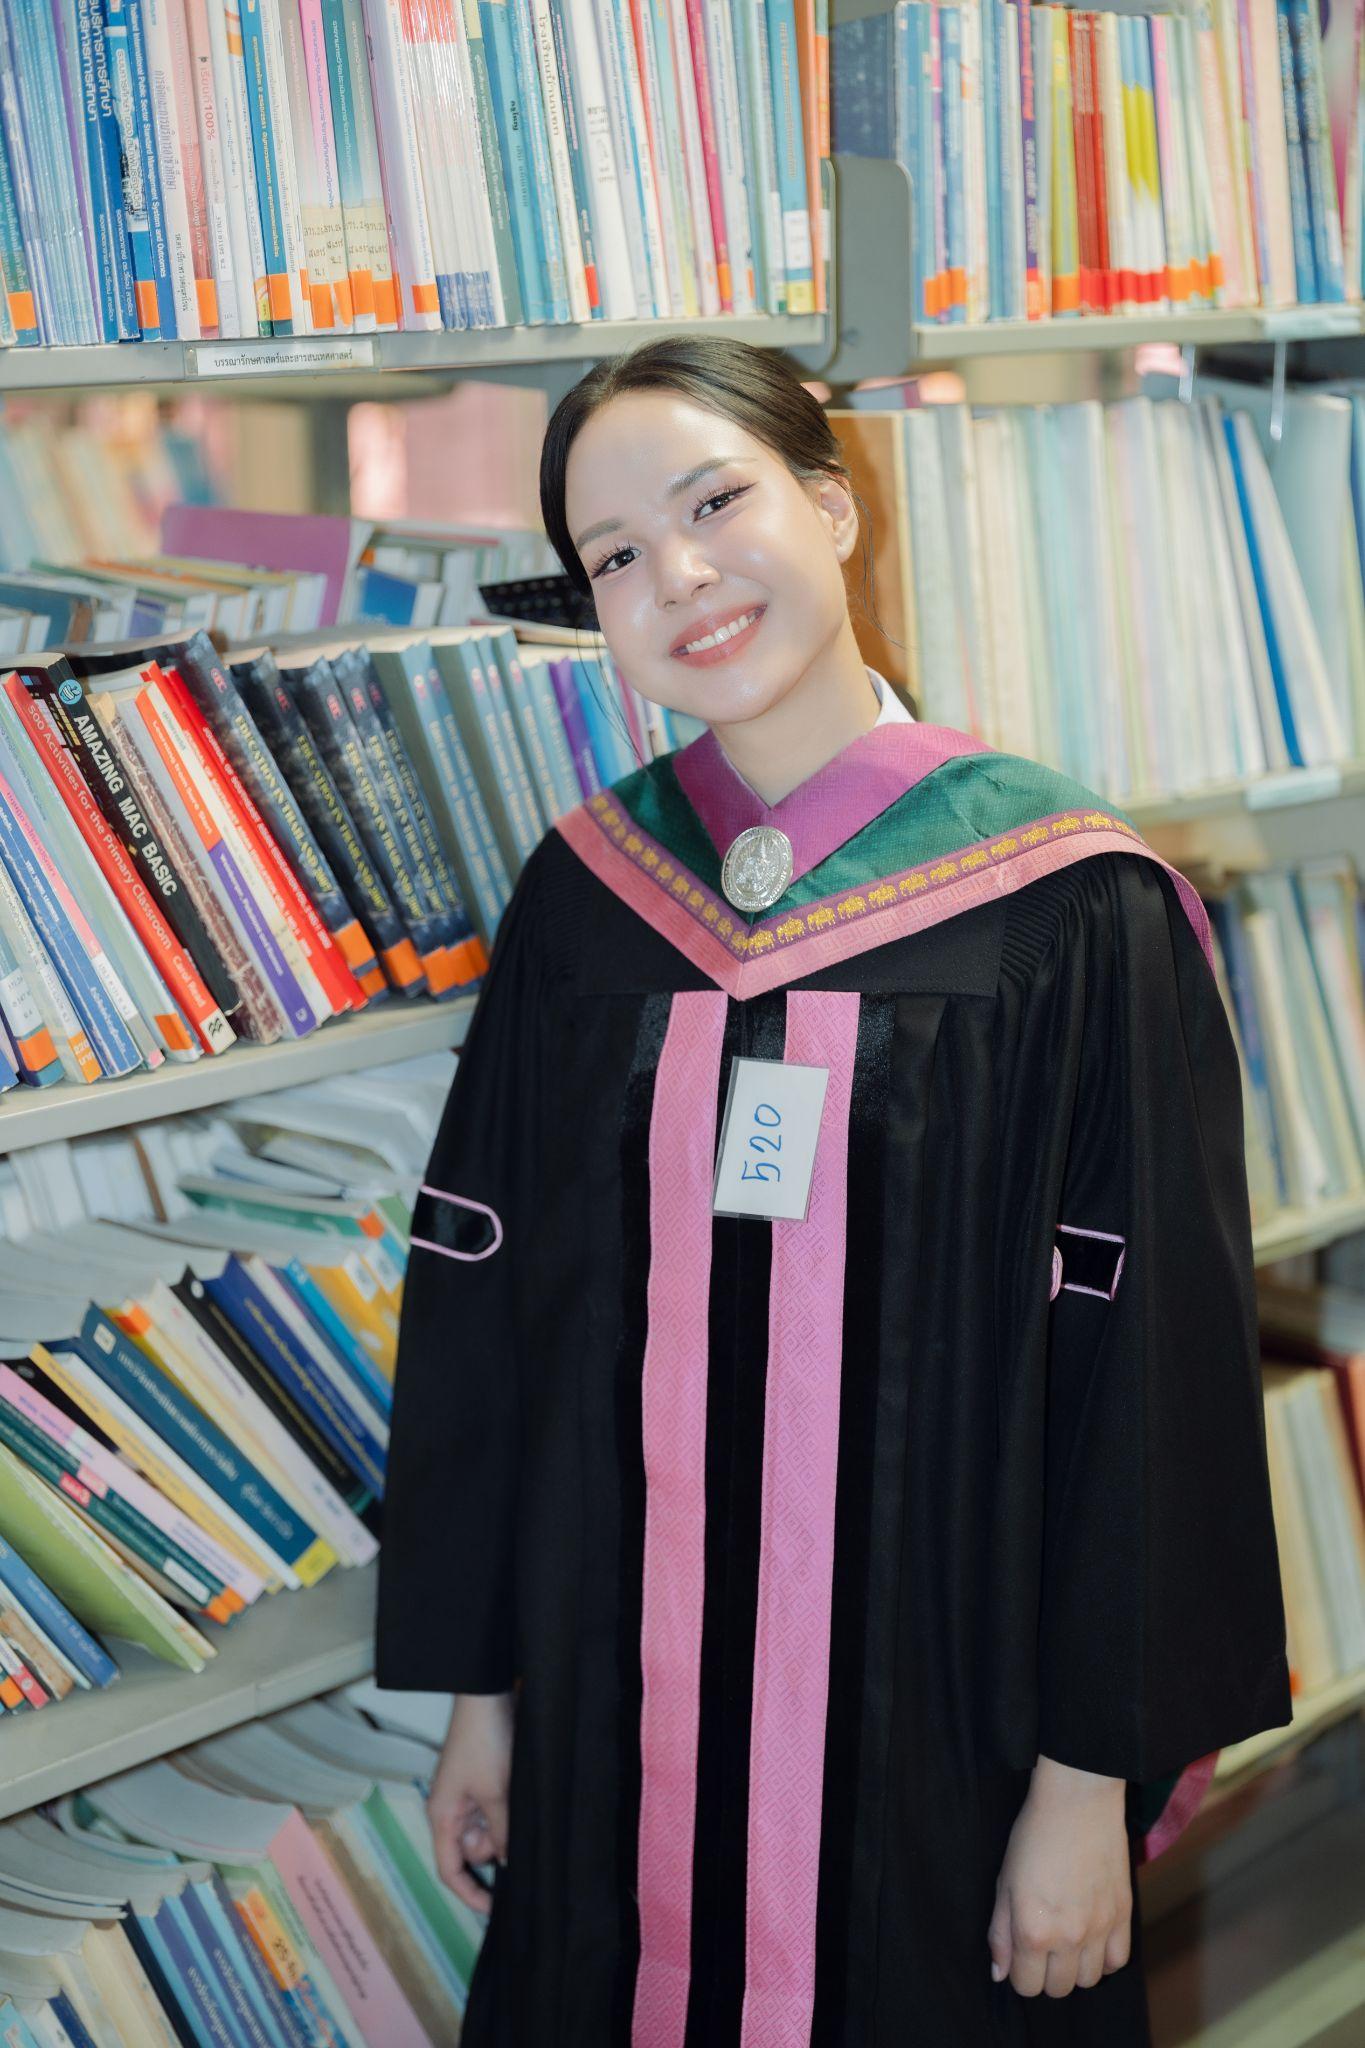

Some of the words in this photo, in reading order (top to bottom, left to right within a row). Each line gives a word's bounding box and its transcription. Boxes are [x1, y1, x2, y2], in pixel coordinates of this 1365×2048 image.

[131, 32, 144, 75] International
[136, 76, 147, 97] Public
[139, 99, 150, 121] Sector
[203, 103, 215, 140] 100%
[142, 123, 154, 154] Standard
[145, 155, 159, 200] Management
[150, 201, 162, 227] System
[154, 228, 164, 242] and
[155, 242, 168, 277] Outcomes
[214, 348, 353, 367] บรรณารักษศาสตร์และสารสนเทศศาสตร์
[73, 711, 124, 794] AMAZING
[117, 796, 148, 839] MAC
[141, 841, 178, 897] BASIC
[173, 763, 189, 787] from
[197, 810, 213, 834] Start
[233, 714, 277, 788] EDUCATION
[271, 787, 286, 805] IN
[279, 803, 320, 869] THAILAND
[26, 704, 45, 730] 500
[42, 731, 81, 790] Activities
[76, 789, 93, 810] for
[88, 811, 106, 834] the
[99, 833, 136, 885] Primary
[129, 882, 174, 949] Classroom
[170, 954, 192, 982] Carol
[742, 1102, 782, 1183] 520
